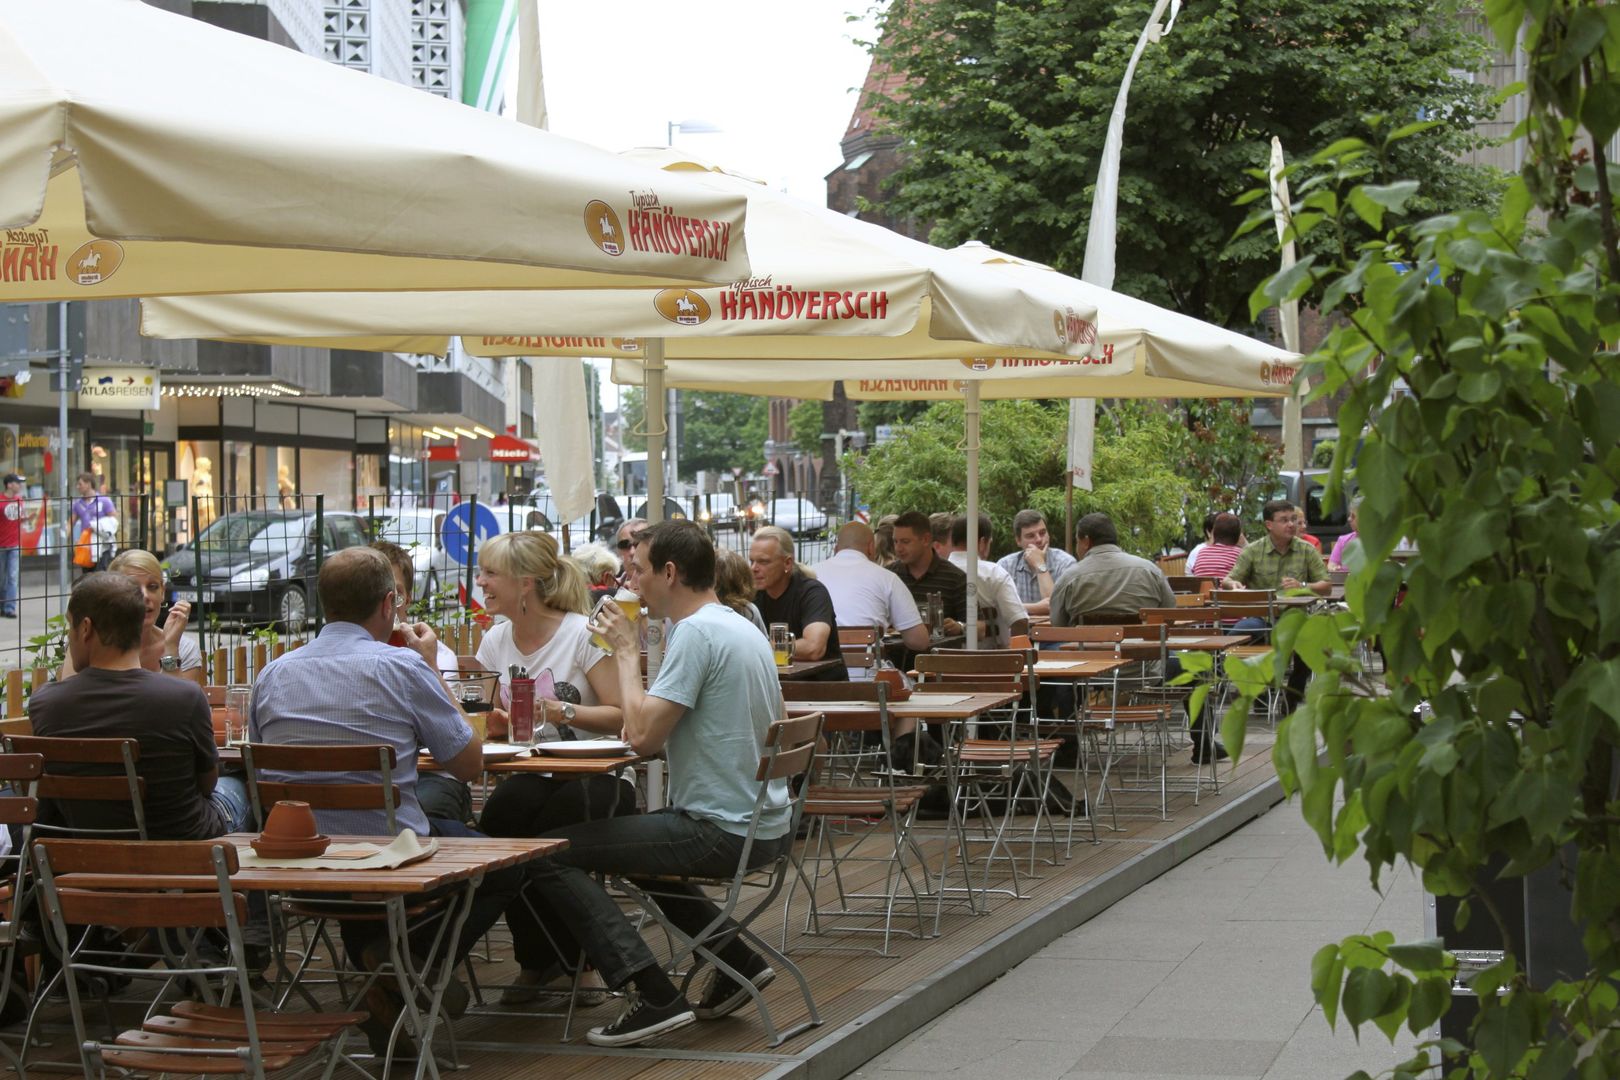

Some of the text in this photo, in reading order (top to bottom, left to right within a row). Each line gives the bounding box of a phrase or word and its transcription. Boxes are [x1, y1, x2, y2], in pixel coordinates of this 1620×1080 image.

[629, 187, 661, 218] Typisch
[628, 206, 731, 261] HANÖVERSCH
[720, 285, 889, 320] HANÖVERSCH
[492, 449, 528, 458] Miele
